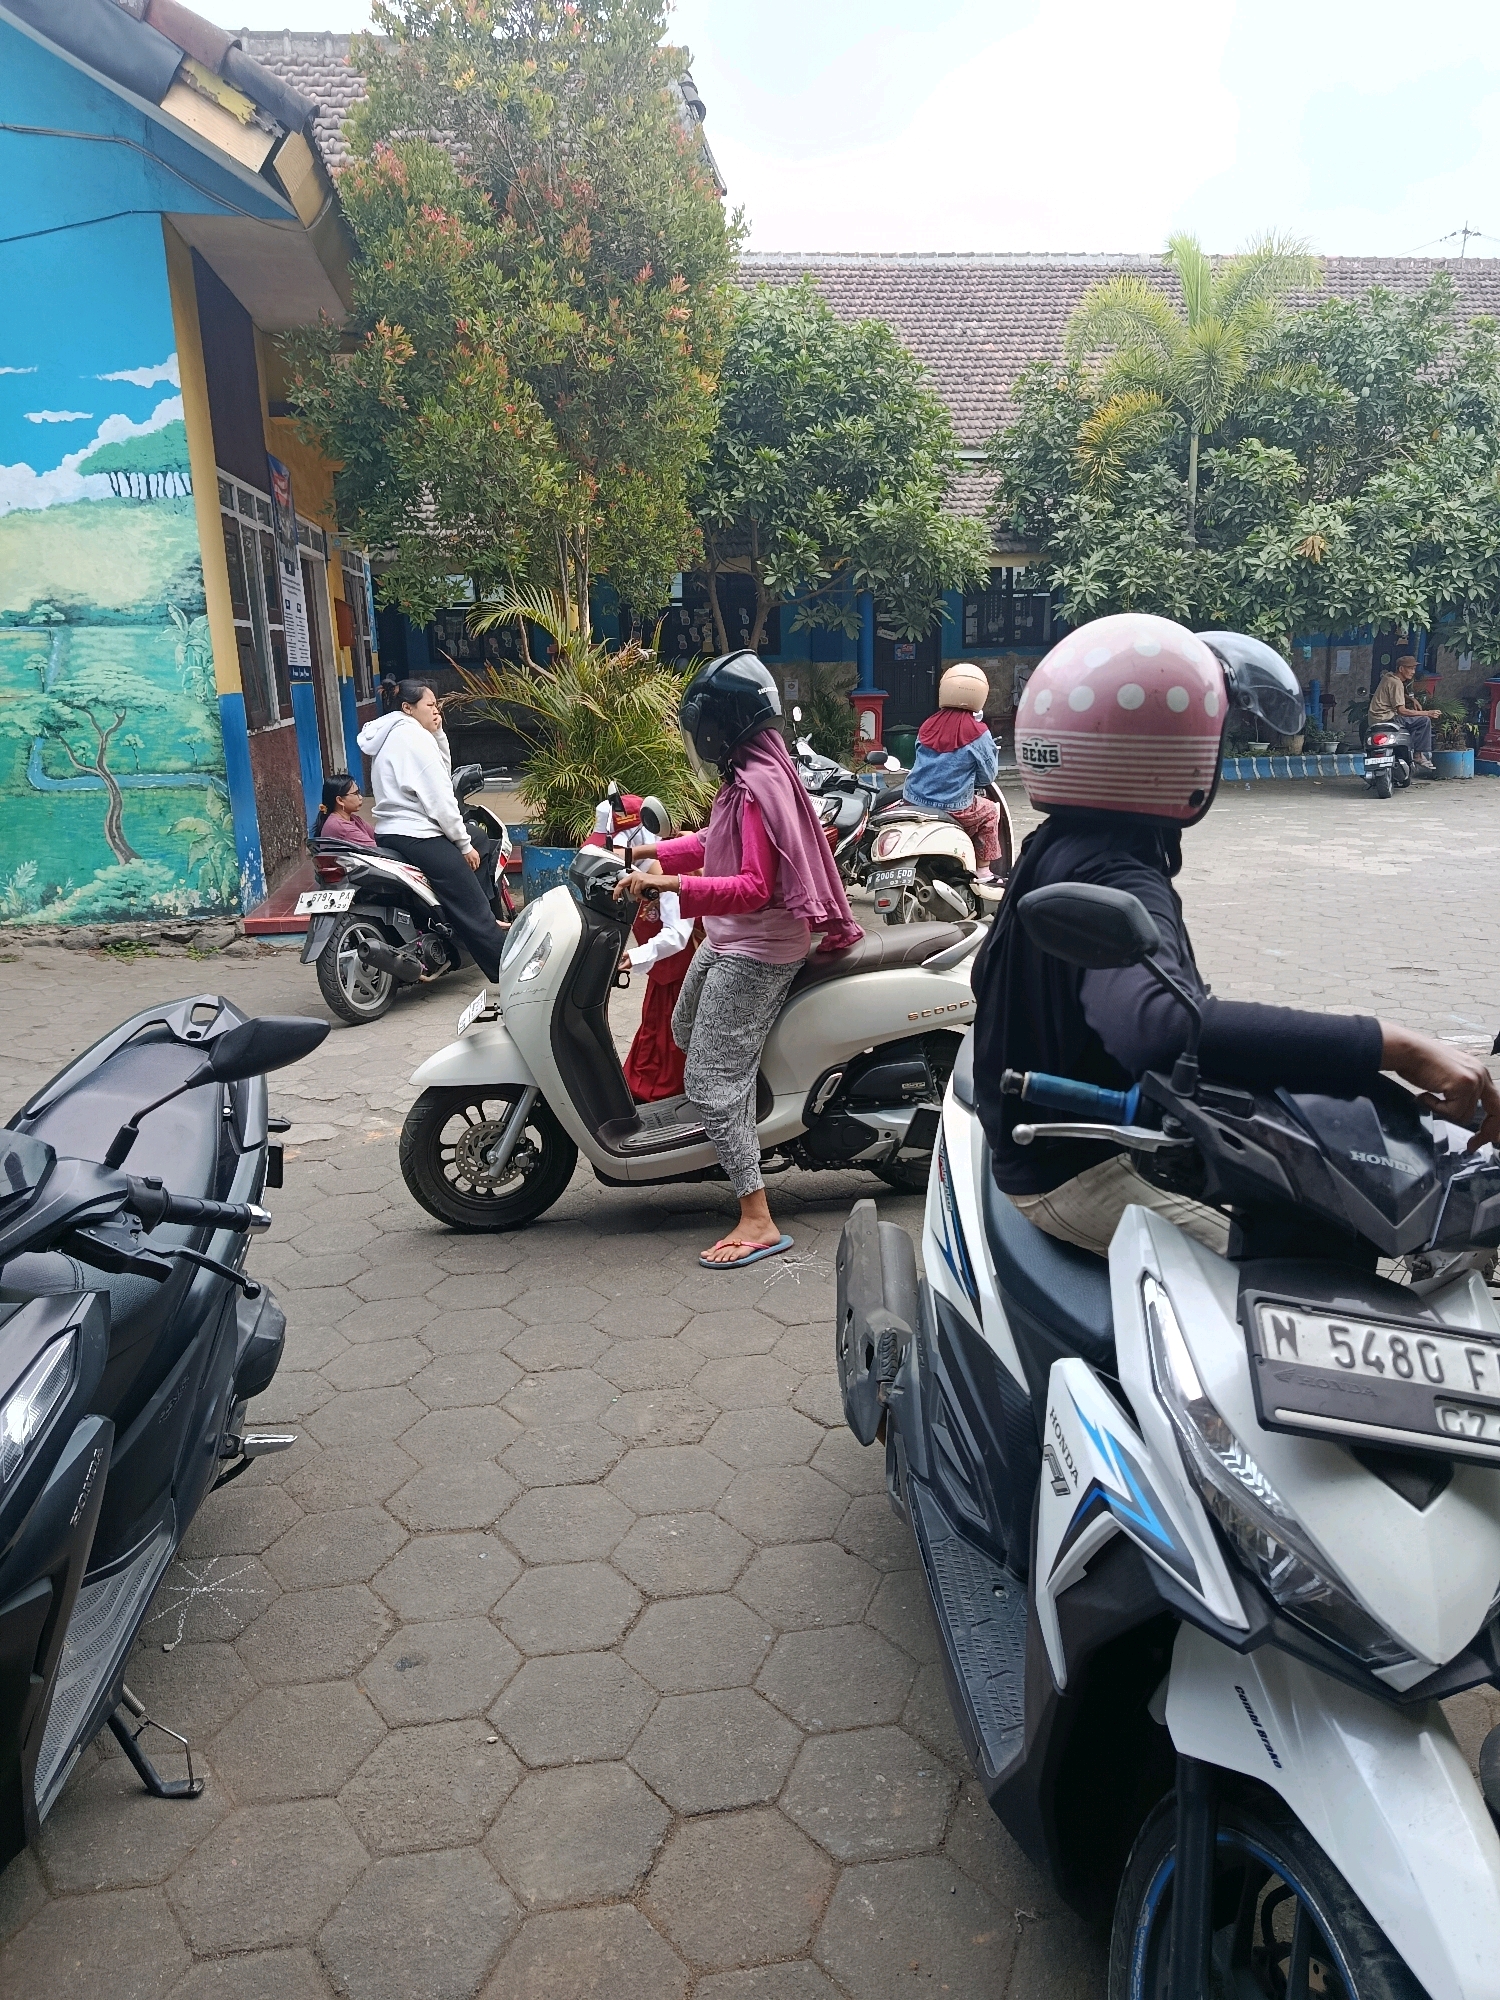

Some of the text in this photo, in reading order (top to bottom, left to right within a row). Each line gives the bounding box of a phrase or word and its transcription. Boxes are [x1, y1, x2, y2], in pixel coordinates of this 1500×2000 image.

[1022, 747, 1059, 763] BENS
[875, 871, 895, 882] 2006
[312, 893, 332, 902] 6797
[339, 892, 350, 900] PA
[1271, 1314, 1500, 1390] N 5480 F
[1297, 1374, 1379, 1398] HONDA
[1050, 1406, 1079, 1488] HONDA
[1234, 1685, 1282, 1768] Combi Brake
